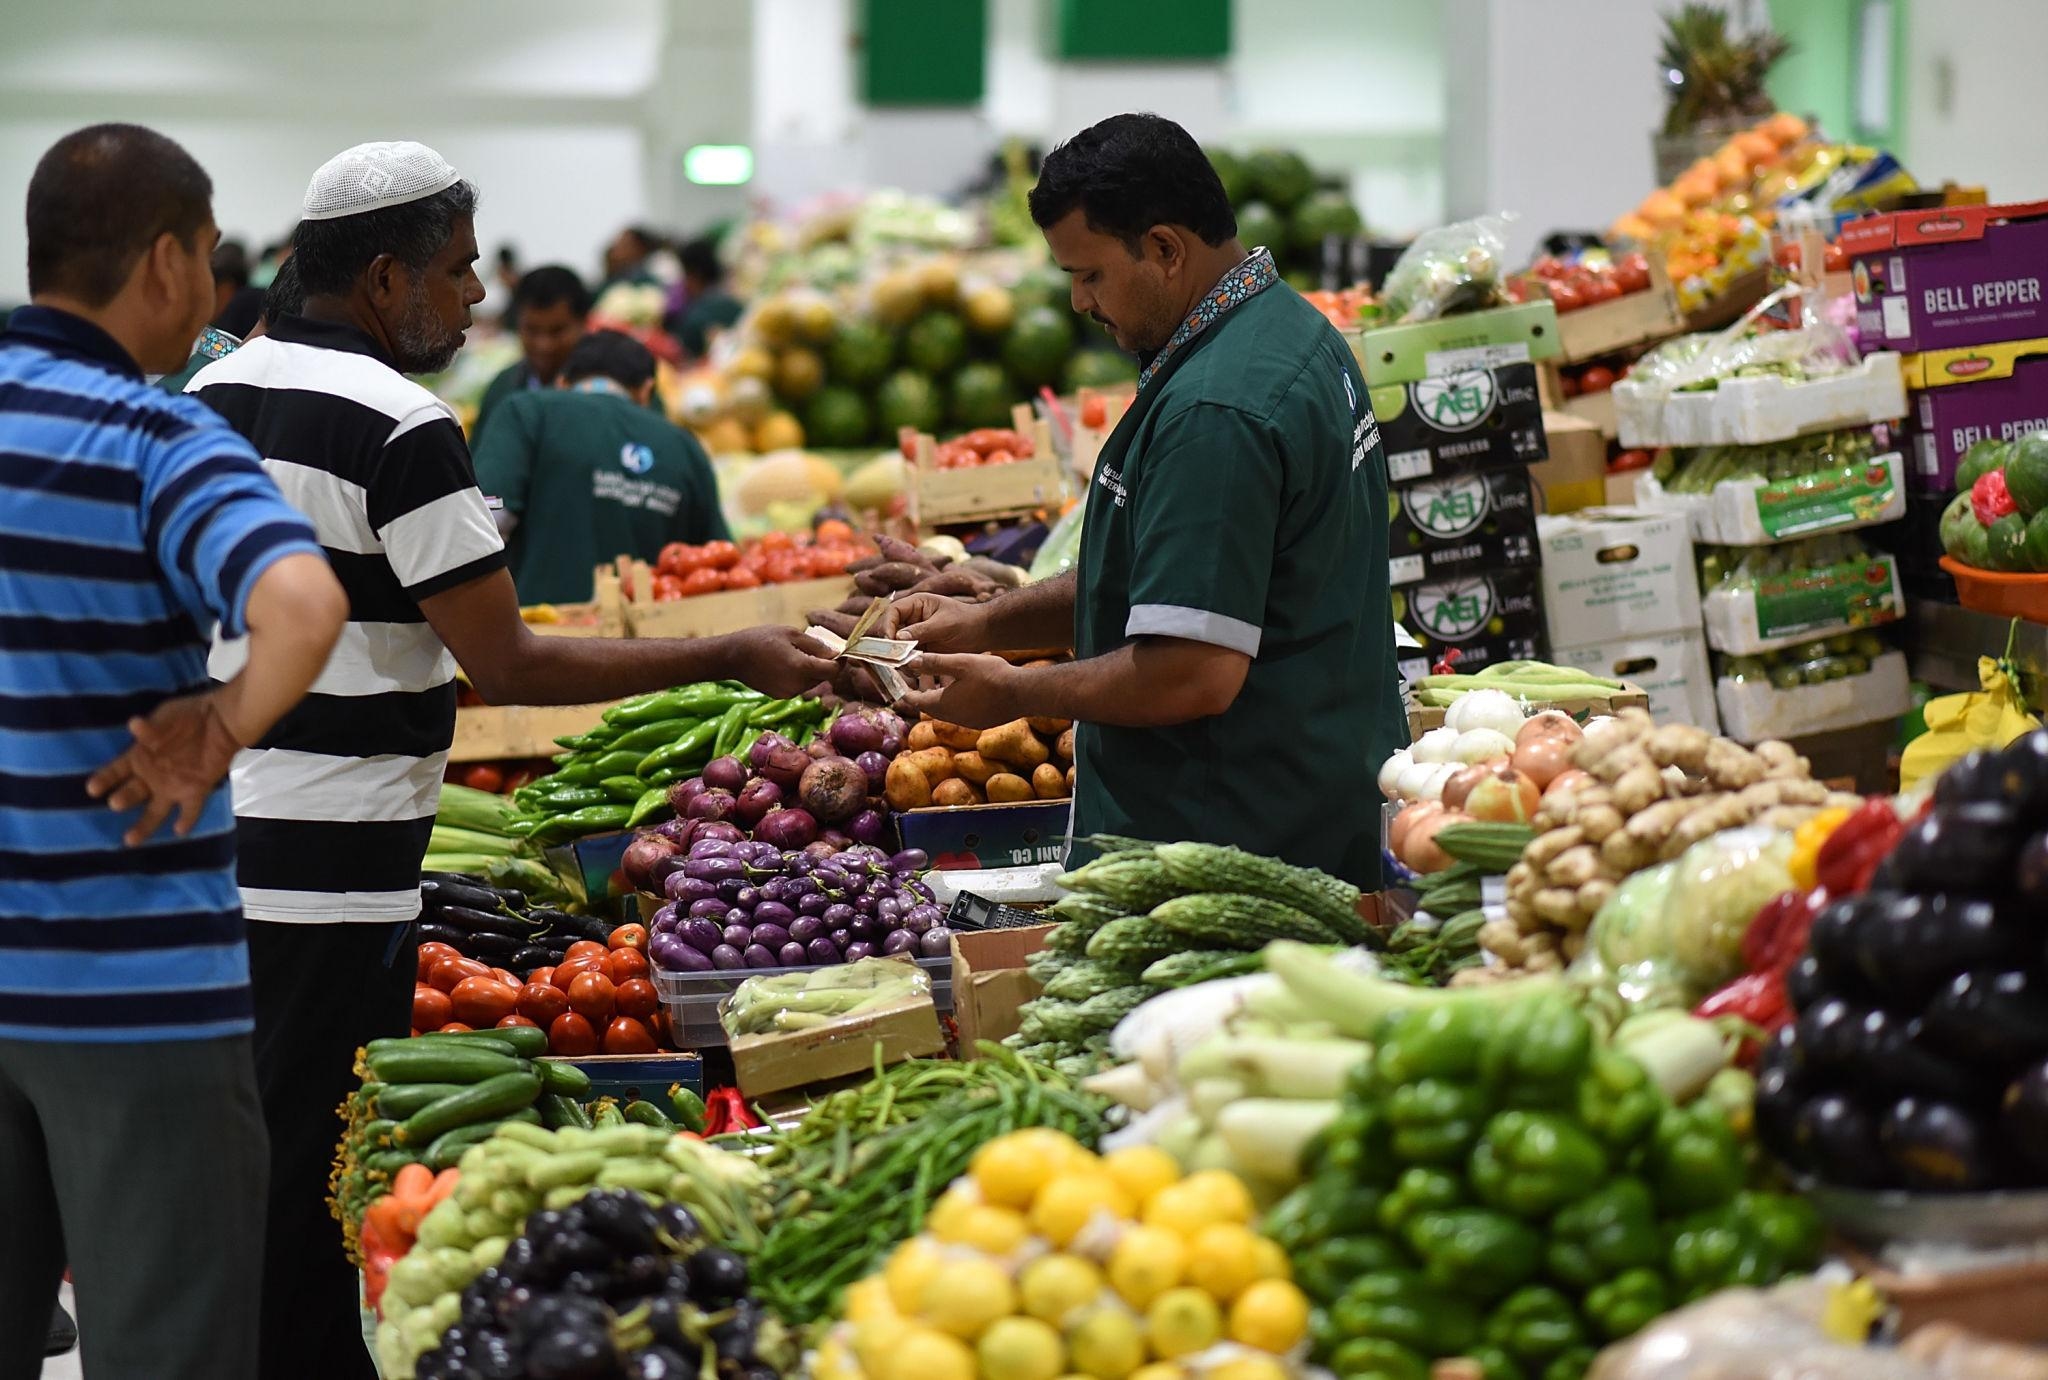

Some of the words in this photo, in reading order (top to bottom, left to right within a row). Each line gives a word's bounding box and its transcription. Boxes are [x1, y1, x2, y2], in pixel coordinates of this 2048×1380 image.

[1924, 286, 1969, 314] BELL
[1972, 277, 2041, 308] PEPPER
[1009, 848, 1032, 865] CO.
[1037, 846, 1061, 862] ANI
